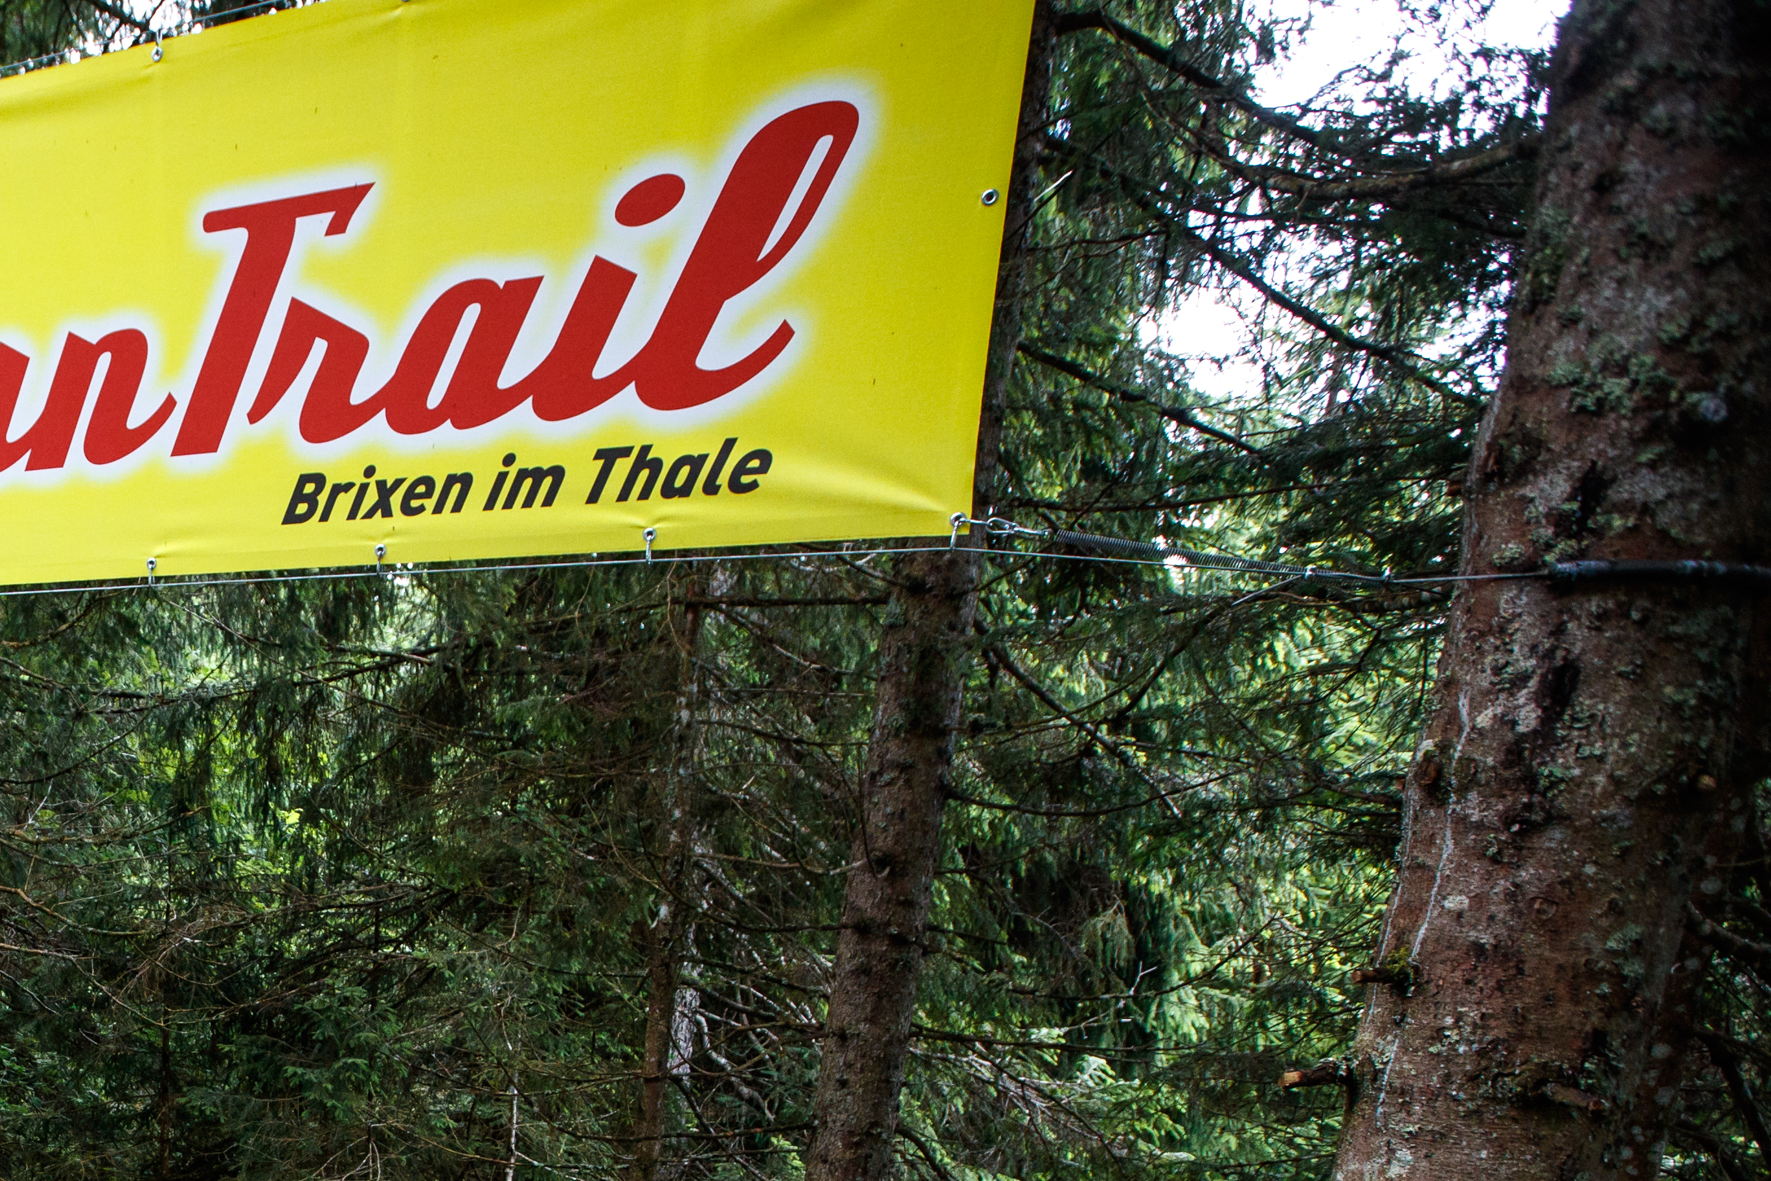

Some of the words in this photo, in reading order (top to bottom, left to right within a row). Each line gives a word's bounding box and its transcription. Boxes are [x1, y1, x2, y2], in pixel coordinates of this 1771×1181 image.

[281, 465, 474, 526] Brixen
[481, 453, 566, 511] im
[584, 445, 773, 505] Thale
